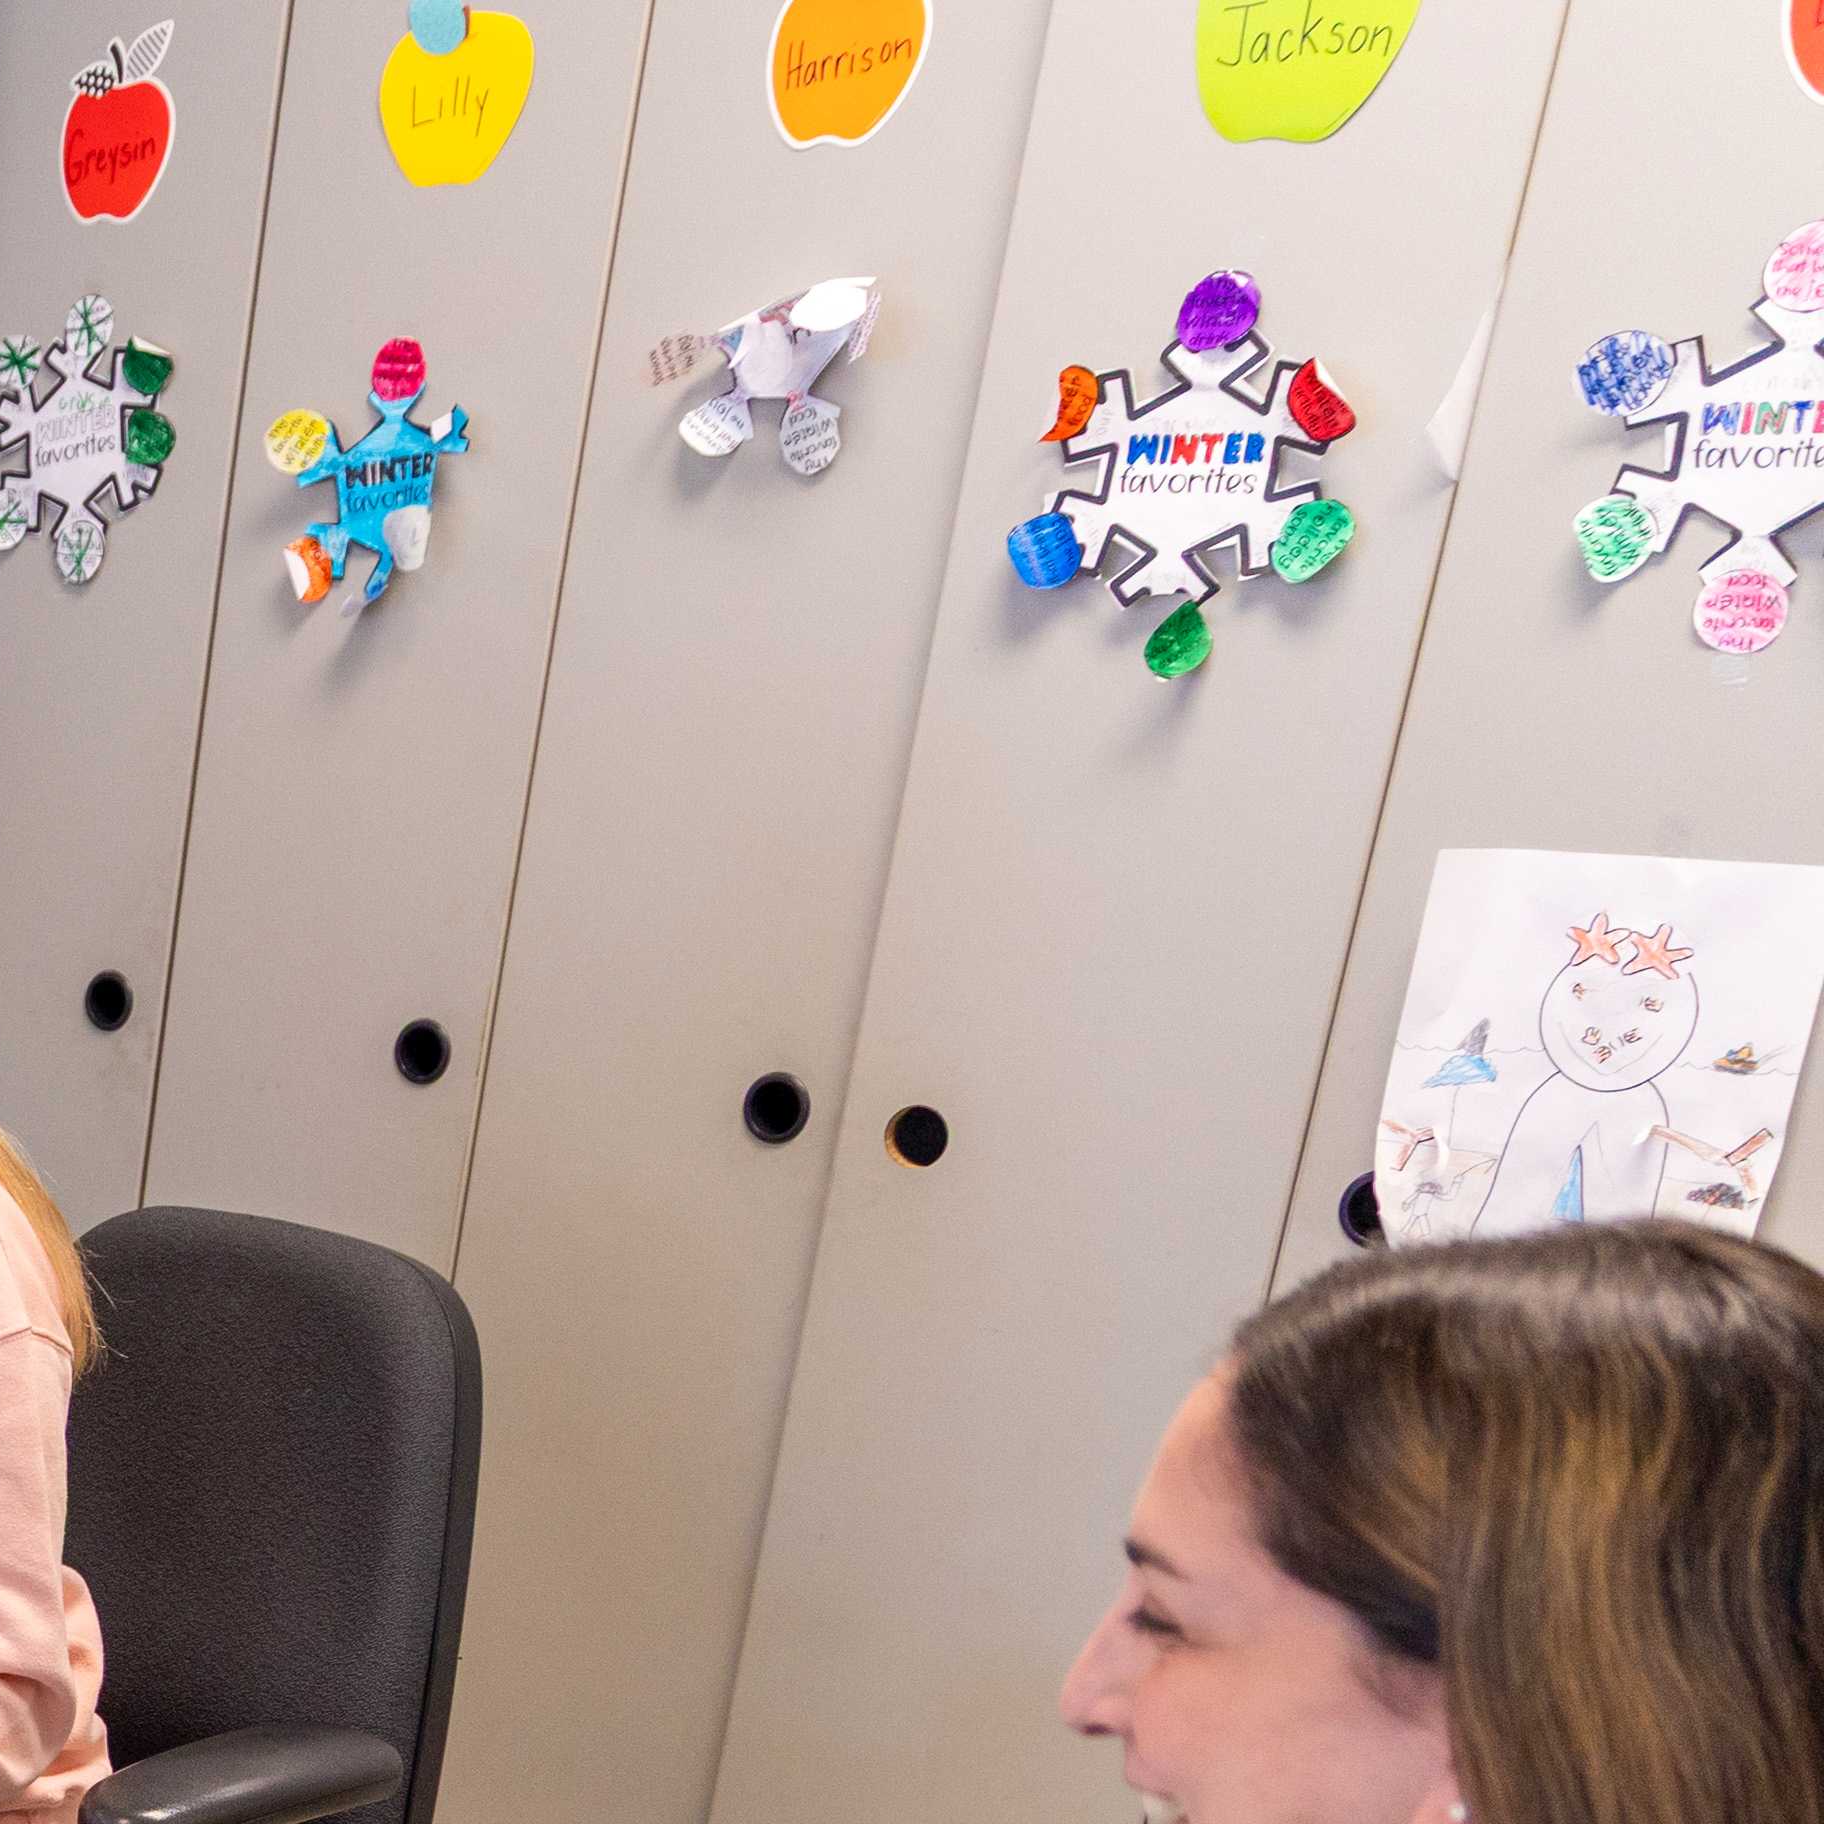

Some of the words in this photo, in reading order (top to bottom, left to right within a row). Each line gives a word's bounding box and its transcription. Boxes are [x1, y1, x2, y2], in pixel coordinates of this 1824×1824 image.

[1216, 0, 1394, 67] Jackson
[786, 37, 913, 91] Harrison
[410, 75, 488, 137] Lilly
[64, 129, 157, 187] Greysin
[35, 407, 116, 443] WINTER
[34, 432, 116, 467] favorites
[1126, 432, 1266, 466] WINTER
[344, 452, 434, 489] WINTER
[1119, 465, 1258, 495] favorites
[345, 481, 430, 513] favorites
[1705, 595, 1782, 611] winter
